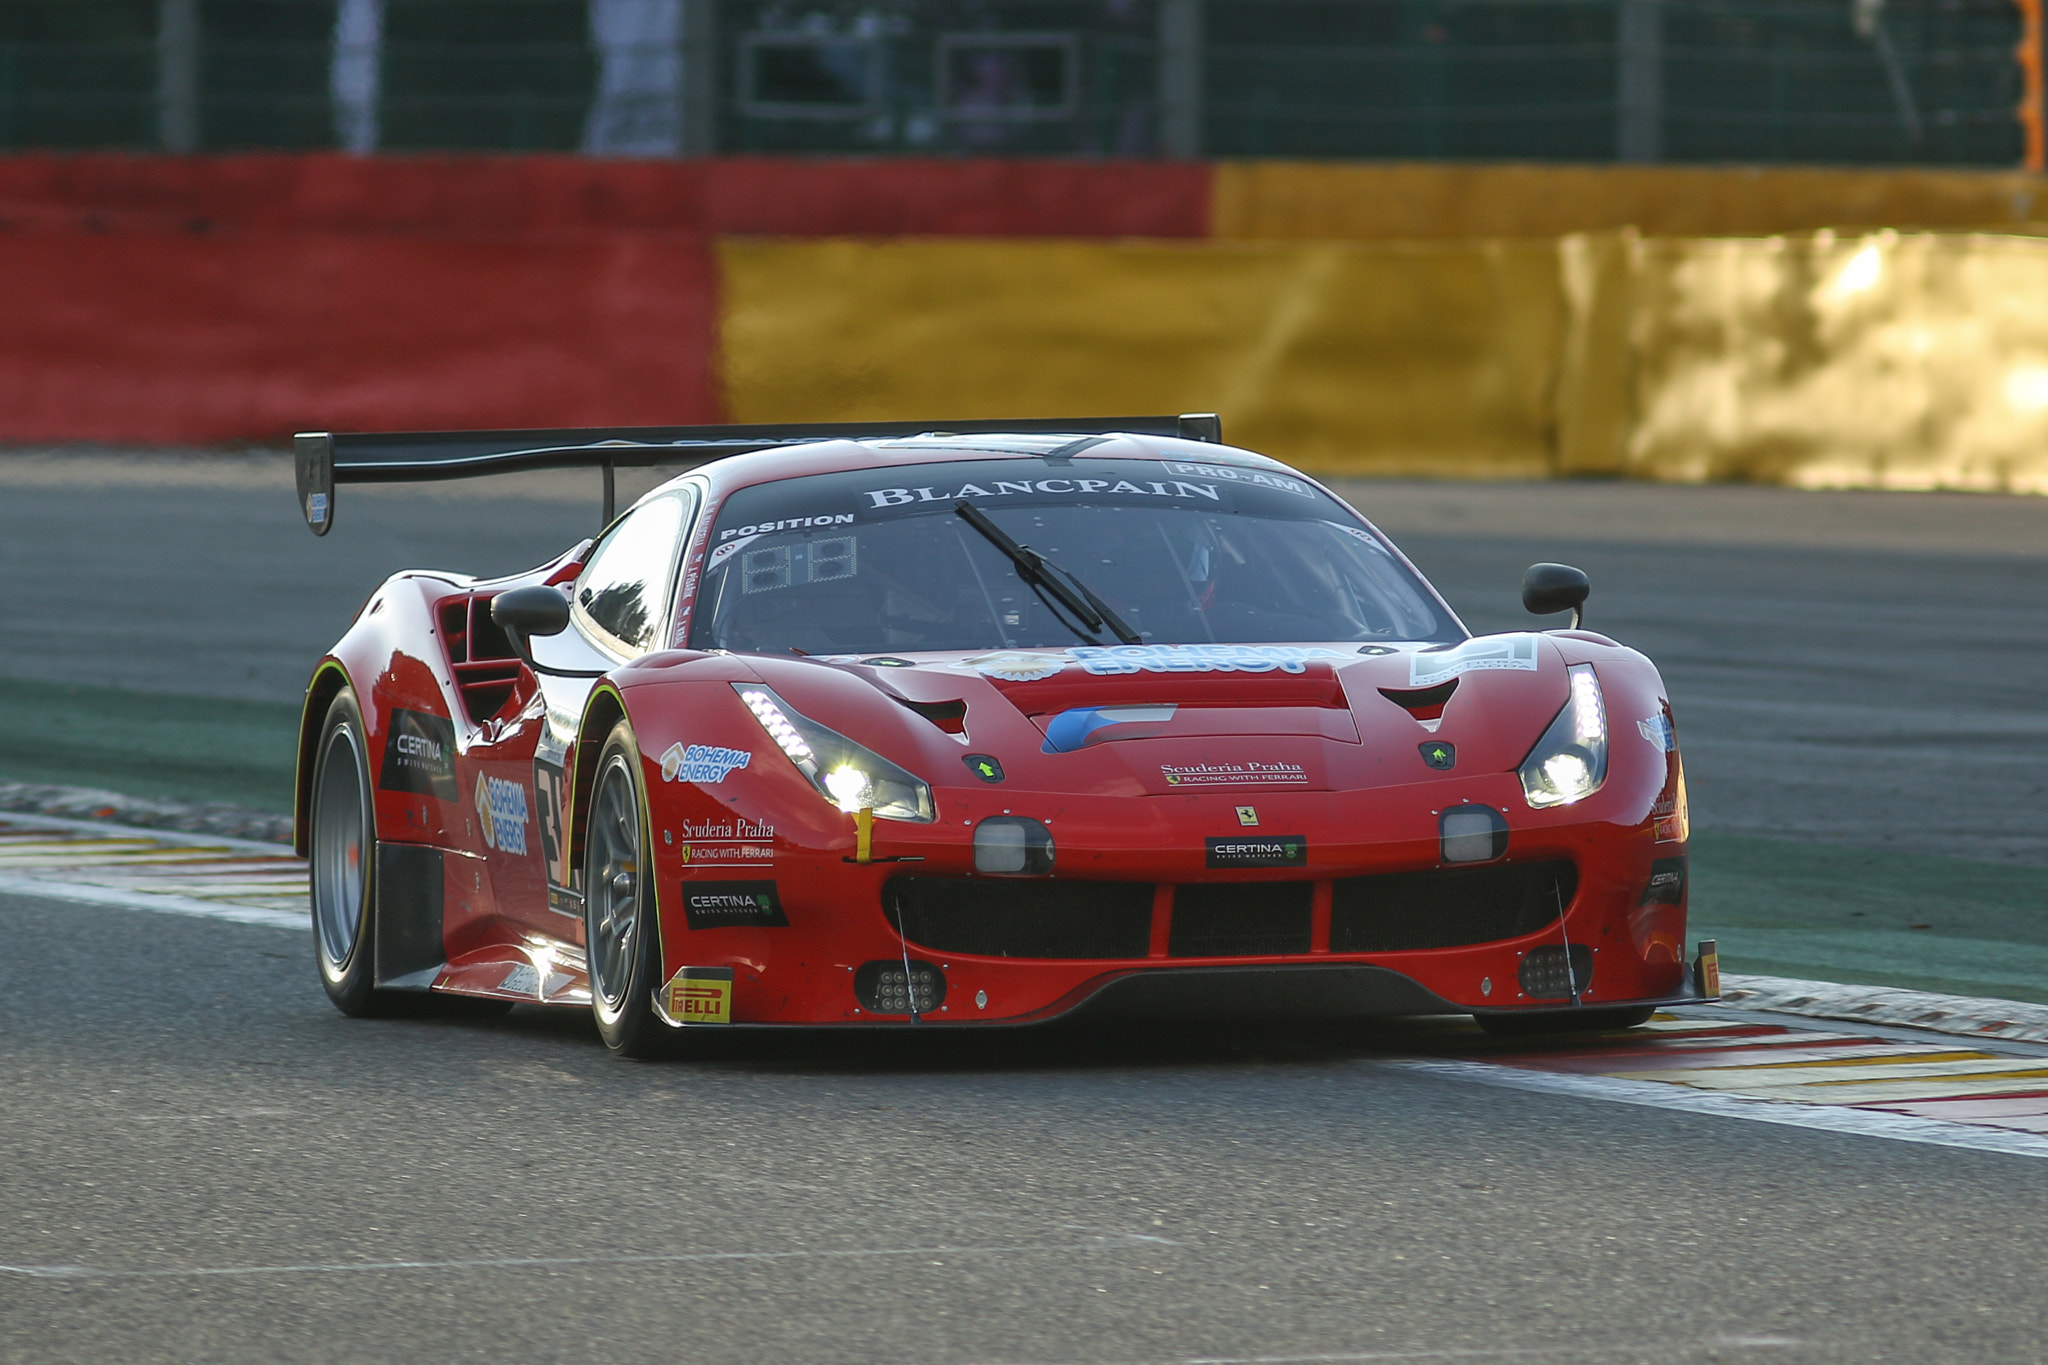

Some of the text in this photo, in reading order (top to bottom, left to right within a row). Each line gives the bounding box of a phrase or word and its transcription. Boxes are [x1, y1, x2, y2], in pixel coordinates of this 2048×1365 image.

[863, 478, 1220, 509] BLANCPAIN
[720, 513, 854, 541] POSITION
[1070, 645, 1349, 661] BOHEMIA
[1079, 657, 1306, 674] ENERGY
[397, 734, 442, 762] CERTINA
[683, 745, 750, 769] BOHEMIA
[679, 764, 731, 783] ENERGY
[1161, 761, 1303, 774] Scuderia Praha
[1183, 775, 1228, 783] RACING
[1229, 774, 1260, 782] WITH
[681, 818, 774, 839] Scuderia Praha
[691, 847, 774, 859] RACING WITH FERRARI
[1214, 843, 1283, 854] CERTINA
[690, 895, 757, 908] CERTINA
[672, 987, 723, 1015] PIRELLI
